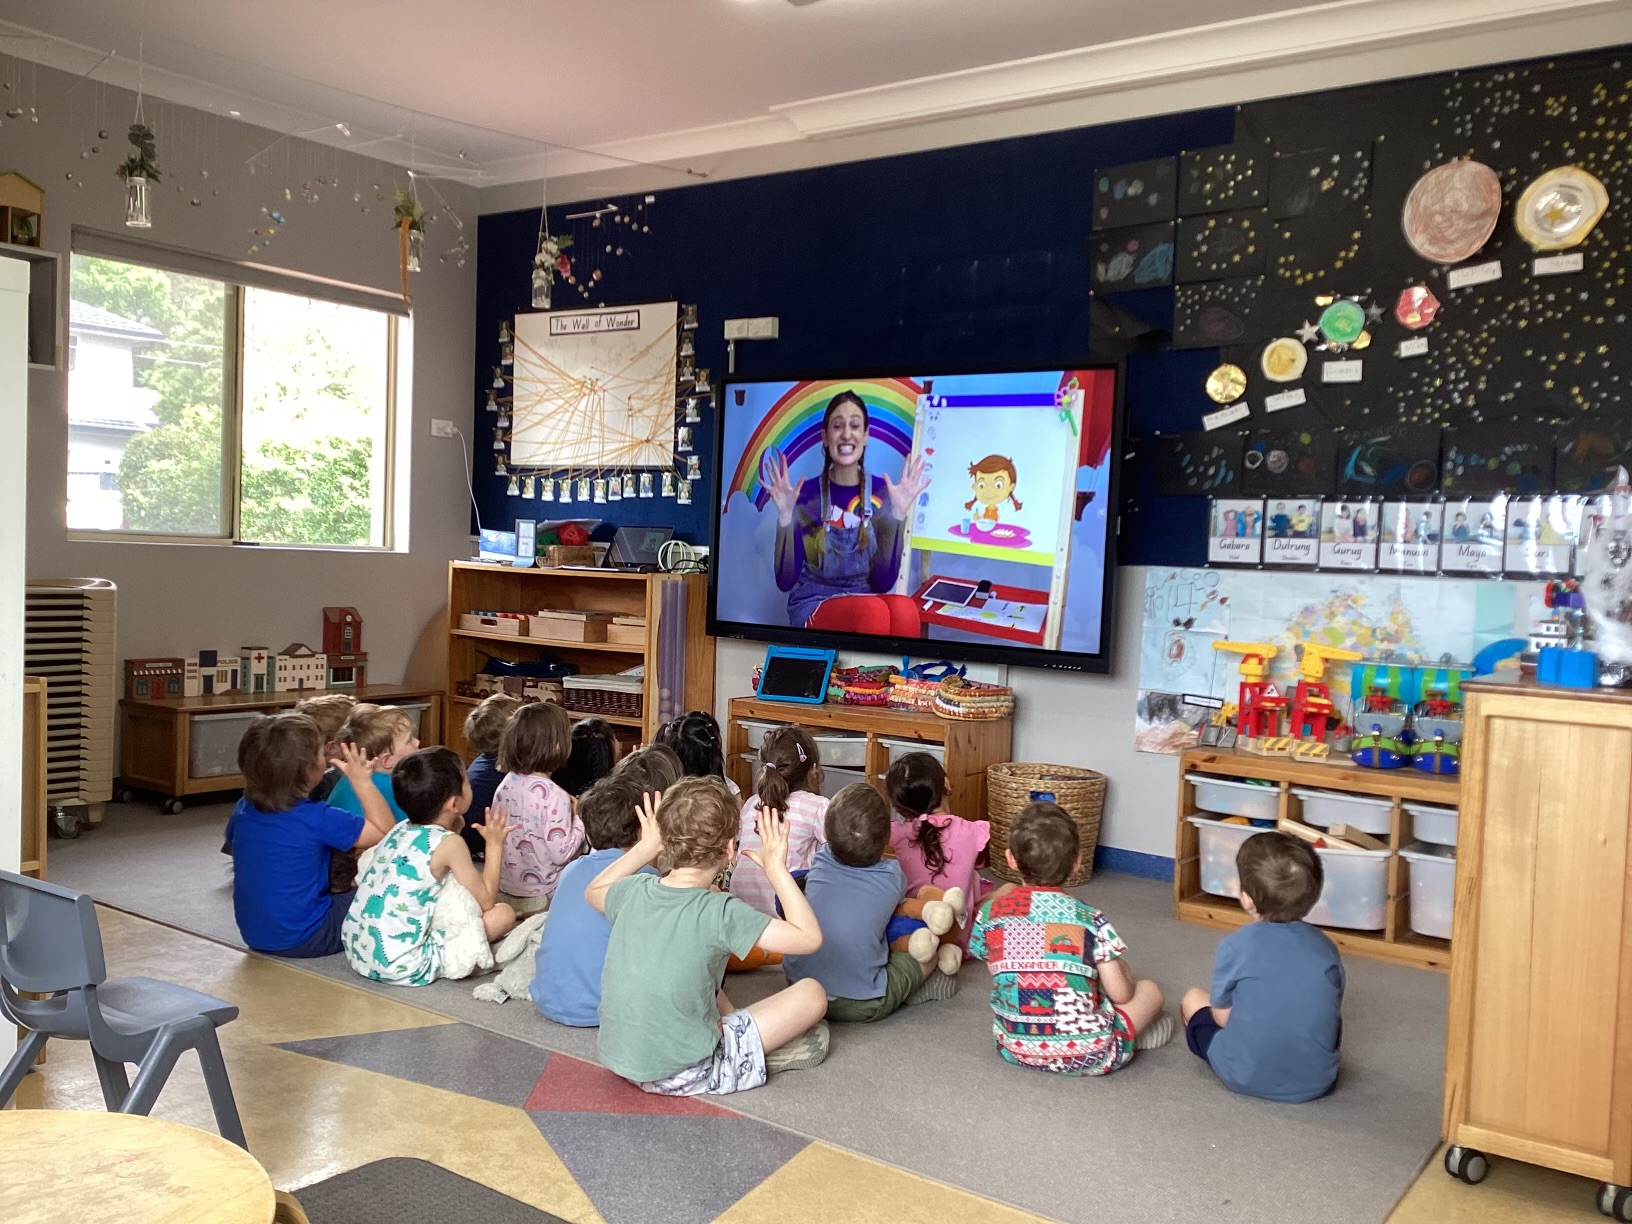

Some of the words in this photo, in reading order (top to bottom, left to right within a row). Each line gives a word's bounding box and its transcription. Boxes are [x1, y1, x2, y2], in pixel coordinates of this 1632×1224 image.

[555, 319, 567, 330] The
[572, 318, 590, 330] Wall
[595, 314, 603, 328] of
[606, 314, 634, 328] Wonder
[1219, 538, 1251, 550] Gabara
[1333, 542, 1362, 560] Gurug
[1000, 961, 1059, 970] ALEXANDER
[1062, 961, 1090, 974] PETER
